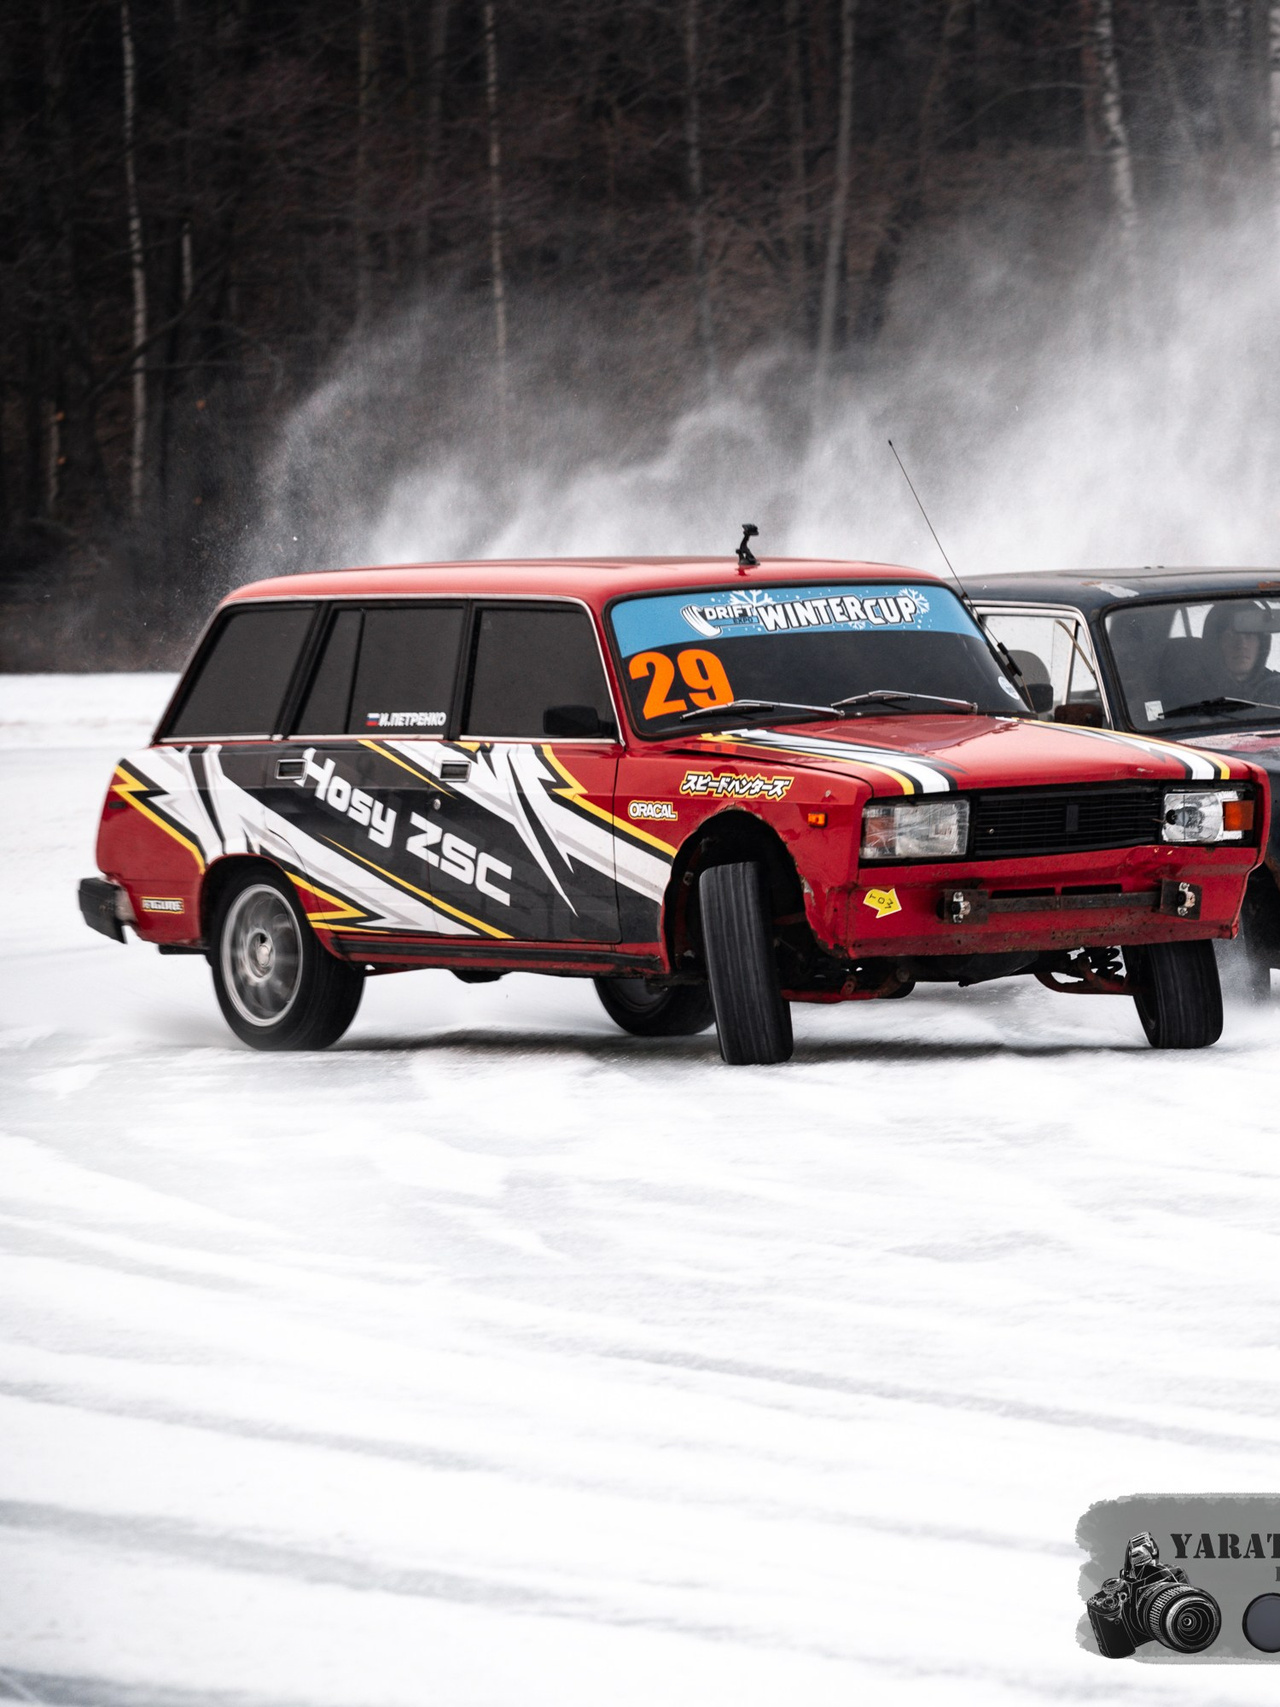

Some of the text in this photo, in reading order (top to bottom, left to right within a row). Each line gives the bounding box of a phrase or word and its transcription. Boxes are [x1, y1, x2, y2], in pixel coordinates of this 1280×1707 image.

[703, 603, 756, 620] DRIFT
[628, 648, 735, 720] 29
[681, 773, 792, 797] スピードハンターズ
[629, 802, 676, 819] ORACAL
[406, 811, 513, 907] ZSC
